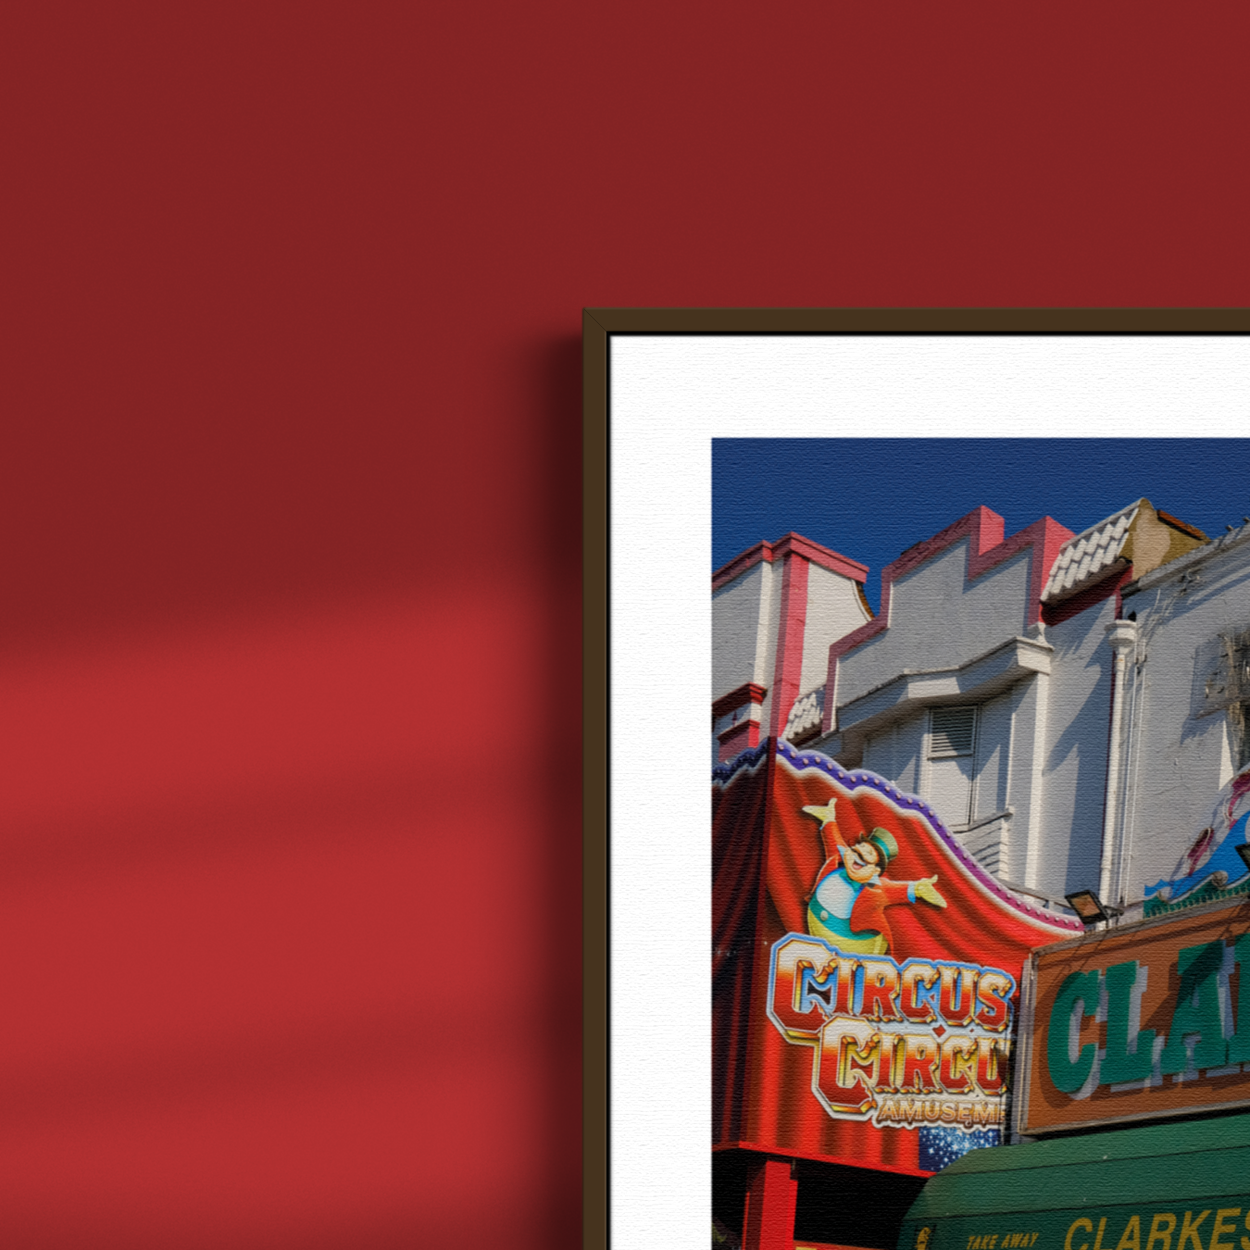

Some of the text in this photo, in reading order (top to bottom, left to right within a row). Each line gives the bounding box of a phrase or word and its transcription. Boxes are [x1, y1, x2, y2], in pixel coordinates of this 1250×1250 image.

[773, 939, 1012, 1039] CIRCUS
[966, 1234, 998, 1250] TAKE
[1000, 1231, 1039, 1250] AWAY
